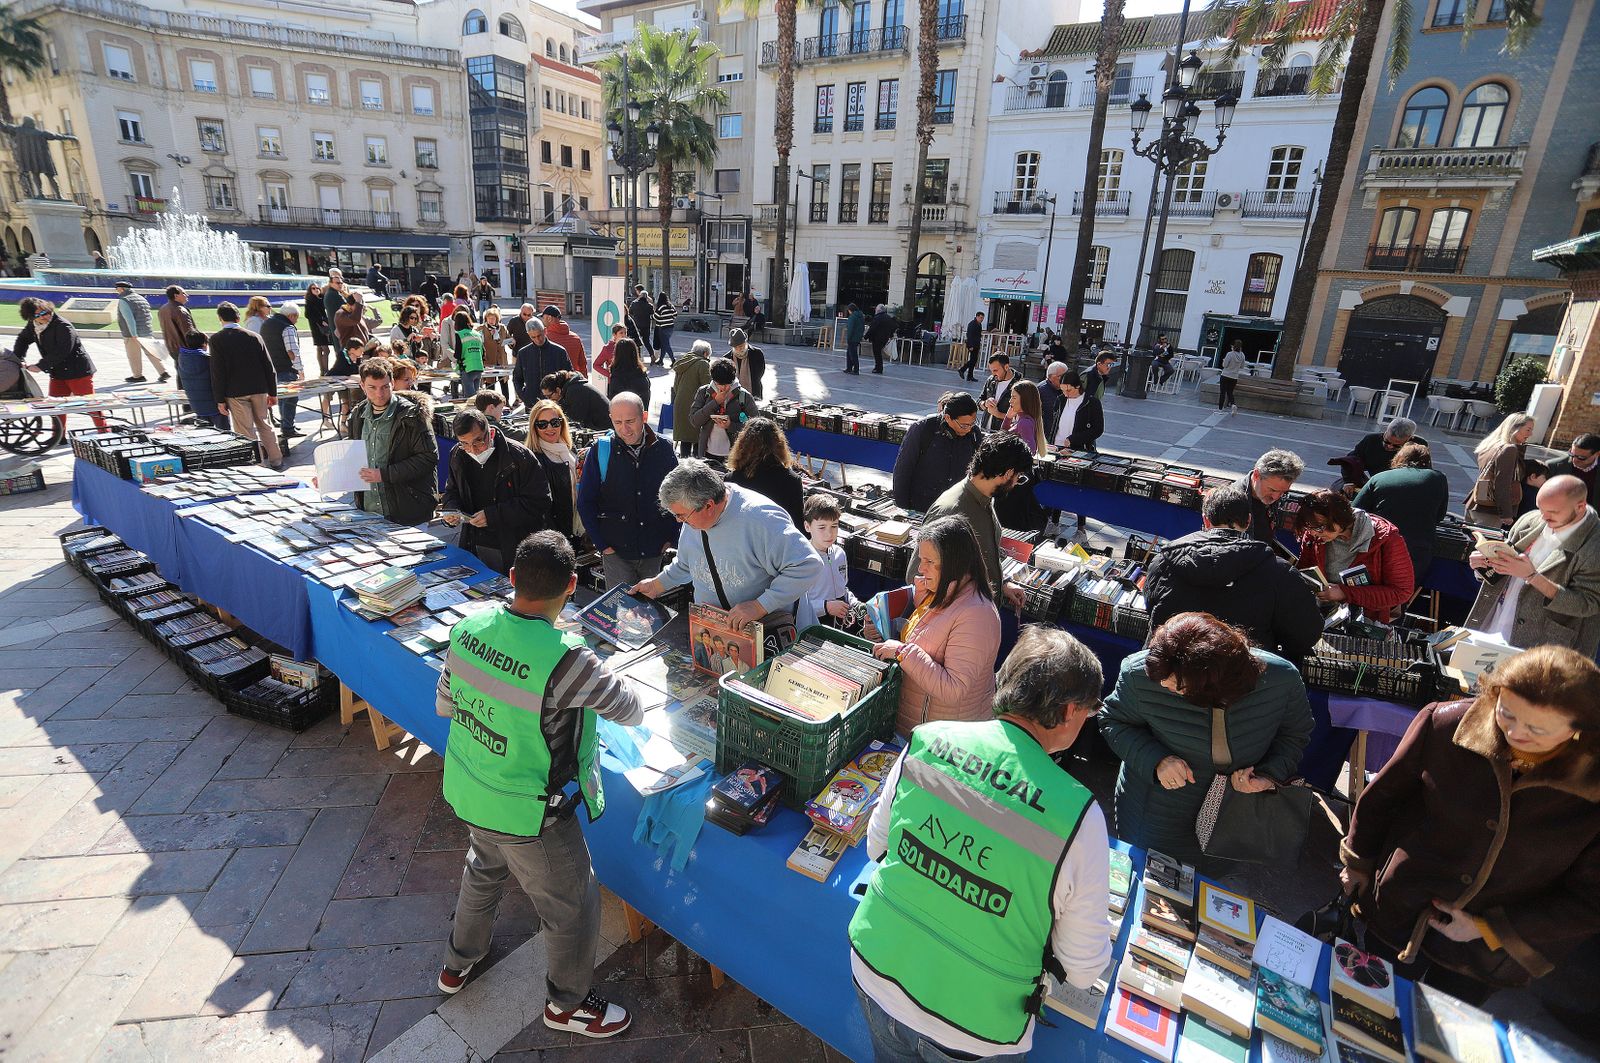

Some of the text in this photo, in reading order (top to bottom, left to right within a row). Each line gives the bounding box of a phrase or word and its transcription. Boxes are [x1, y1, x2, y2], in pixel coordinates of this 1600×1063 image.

[457, 630, 531, 679] PARAMEDIC
[455, 688, 495, 723] AYRE
[927, 737, 1046, 813] MEDICAL
[918, 814, 992, 870] AYRE
[899, 838, 1008, 912] SOLIDARIO
